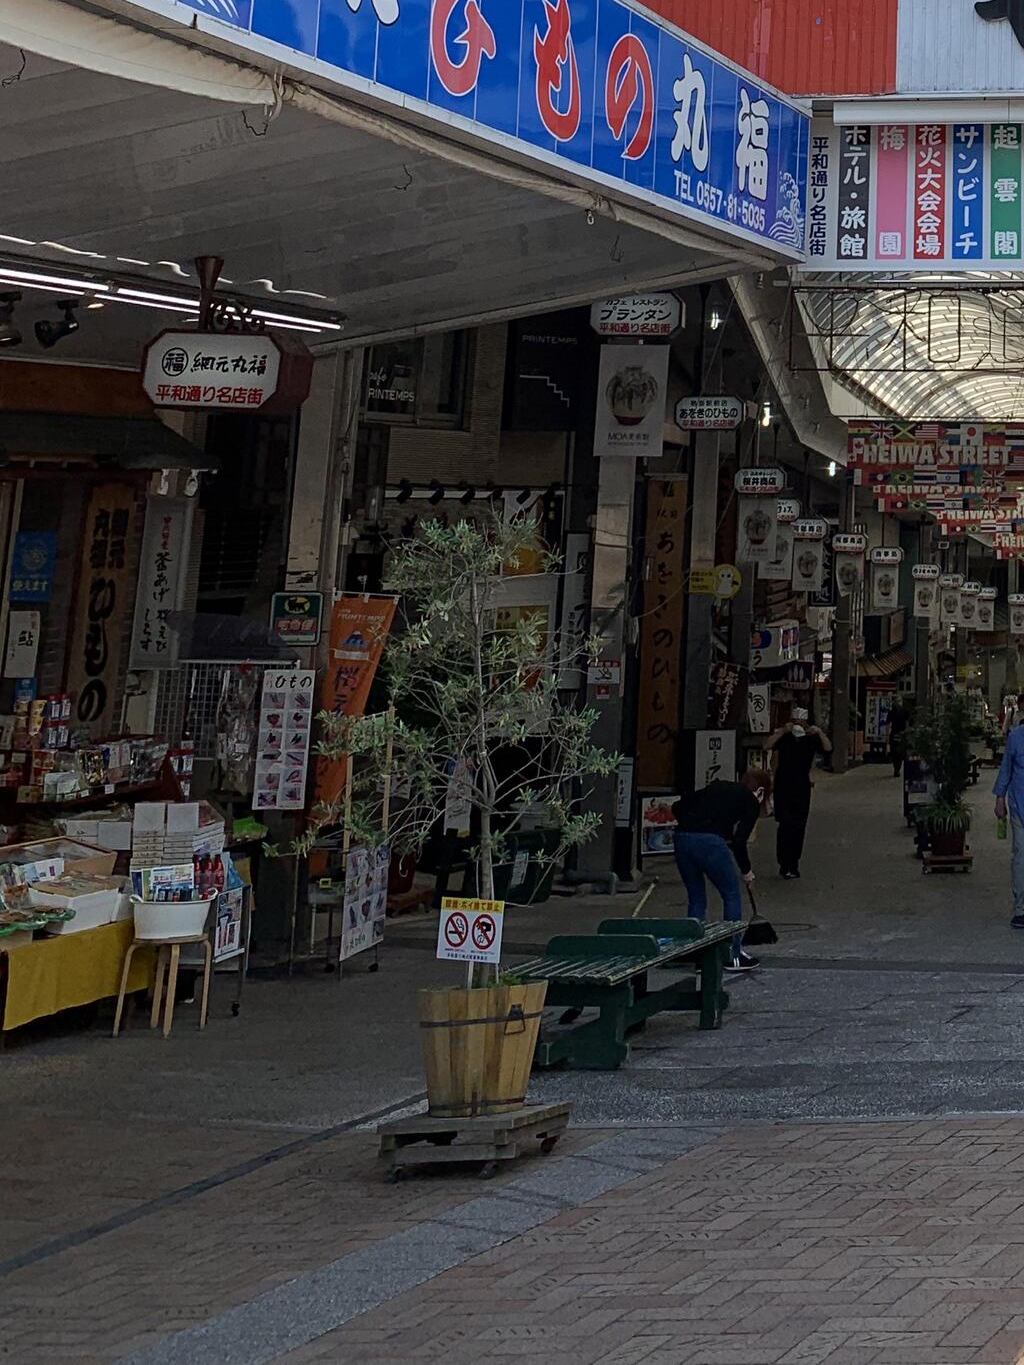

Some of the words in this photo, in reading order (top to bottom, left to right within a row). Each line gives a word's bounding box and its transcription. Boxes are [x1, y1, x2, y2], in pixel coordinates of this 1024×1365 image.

[674, 169, 694, 202] TEL
[807, 136, 828, 258] 平和通り名店街
[839, 124, 865, 257] ホテル・旅館
[916, 124, 943, 257] 花火大会会場
[955, 124, 980, 255] サンビーチ
[993, 124, 1018, 255] 起雲閣
[600, 322, 672, 333] 平和通り名店街
[601, 306, 671, 321] プランタン
[155, 384, 263, 405] 平和通り名店街
[679, 408, 738, 418] あをきのひもの
[862, 444, 935, 465] HEIWA
[937, 443, 1012, 466] STREET
[275, 674, 312, 689] ひもの
